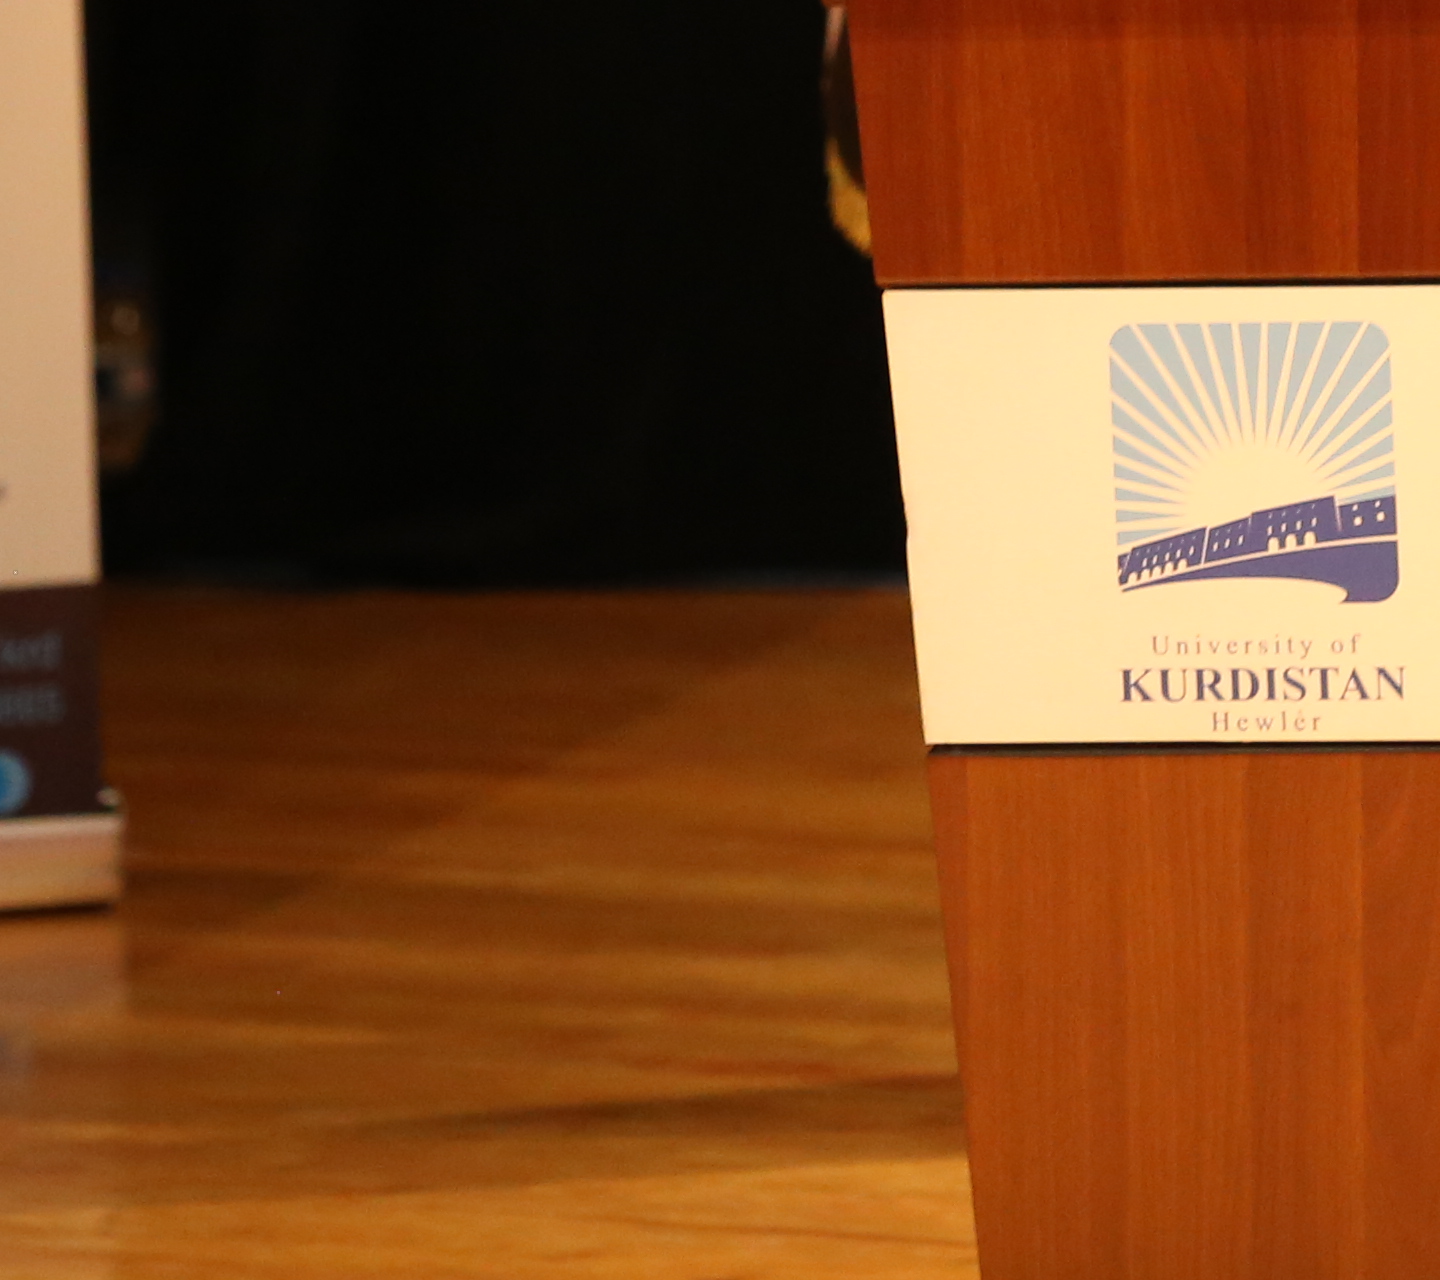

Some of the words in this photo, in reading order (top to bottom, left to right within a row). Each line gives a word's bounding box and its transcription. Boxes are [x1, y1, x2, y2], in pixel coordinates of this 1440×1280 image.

[1151, 633, 1313, 659] University
[1330, 632, 1361, 654] of
[1119, 665, 1407, 704] KURDISTAN
